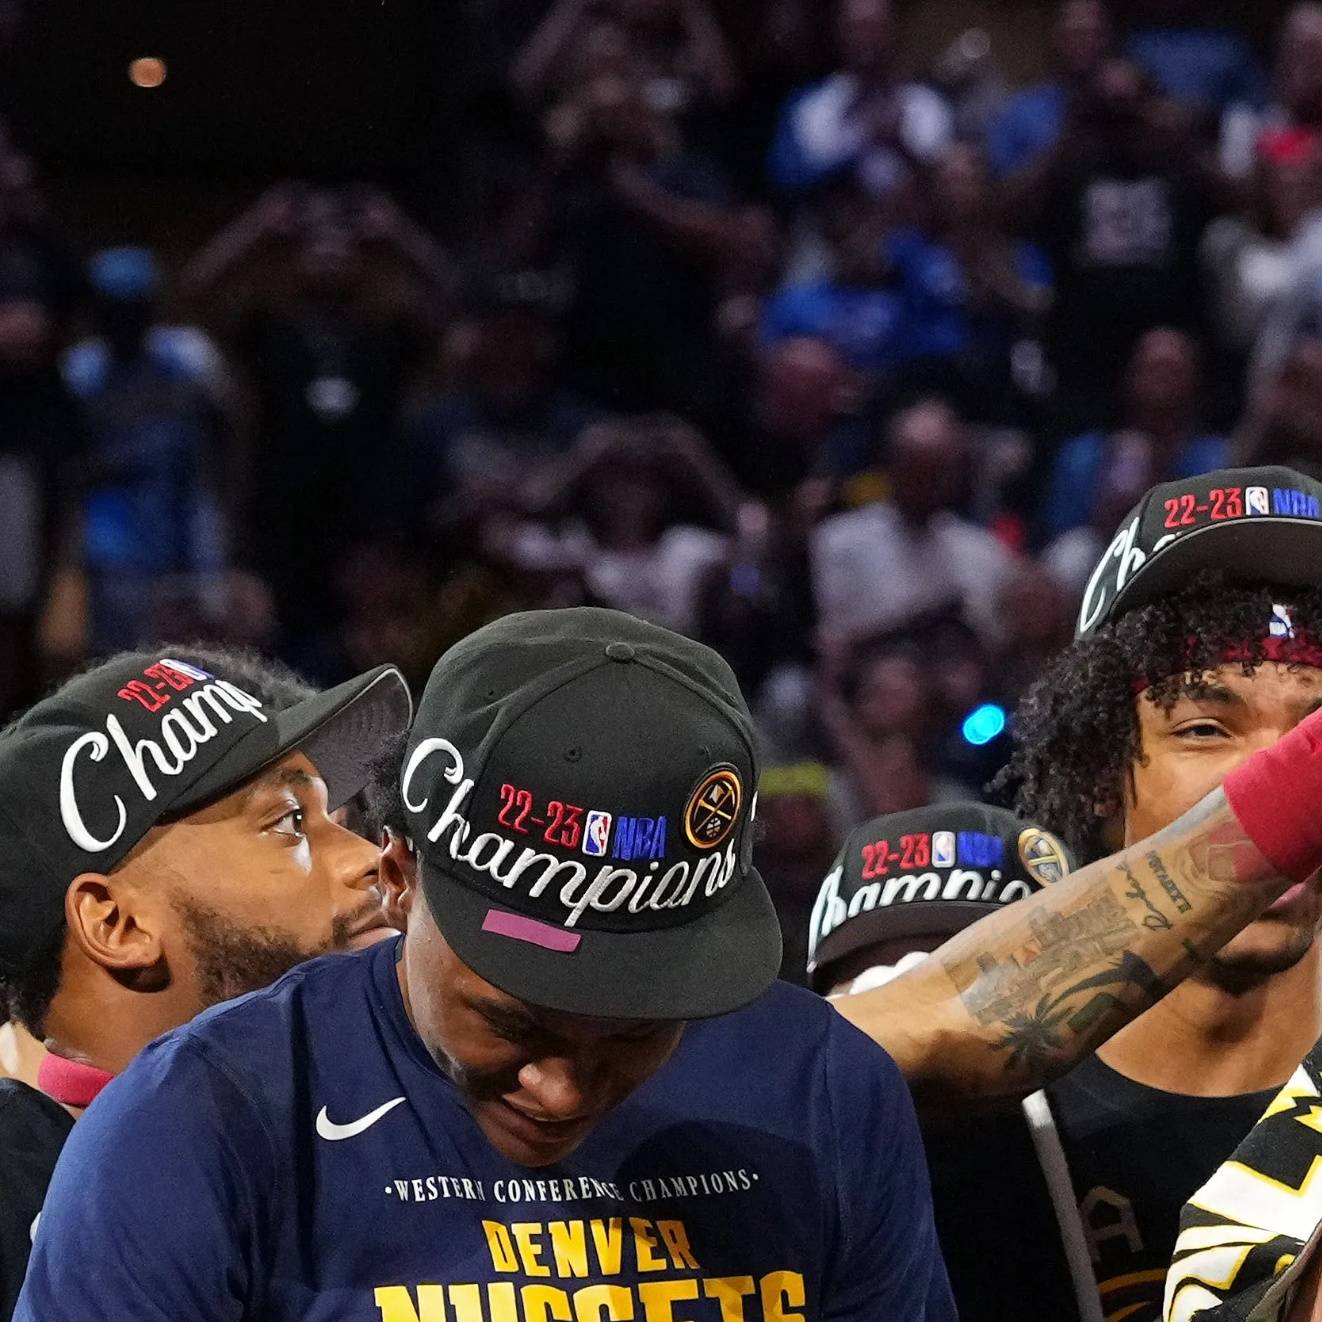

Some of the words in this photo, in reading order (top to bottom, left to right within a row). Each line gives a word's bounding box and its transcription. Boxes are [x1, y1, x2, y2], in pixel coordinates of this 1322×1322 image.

[1163, 486, 1242, 528] 22-23
[402, 737, 737, 928] Champions
[497, 783, 586, 849] 22-23
[612, 815, 668, 861] NBA
[861, 830, 932, 881] 22-23
[392, 1178, 485, 1203] WESTERN
[493, 1175, 620, 1203] CONFERENCE
[629, 1168, 751, 1203] CHAMPIONS
[481, 1215, 700, 1279] DENVER
